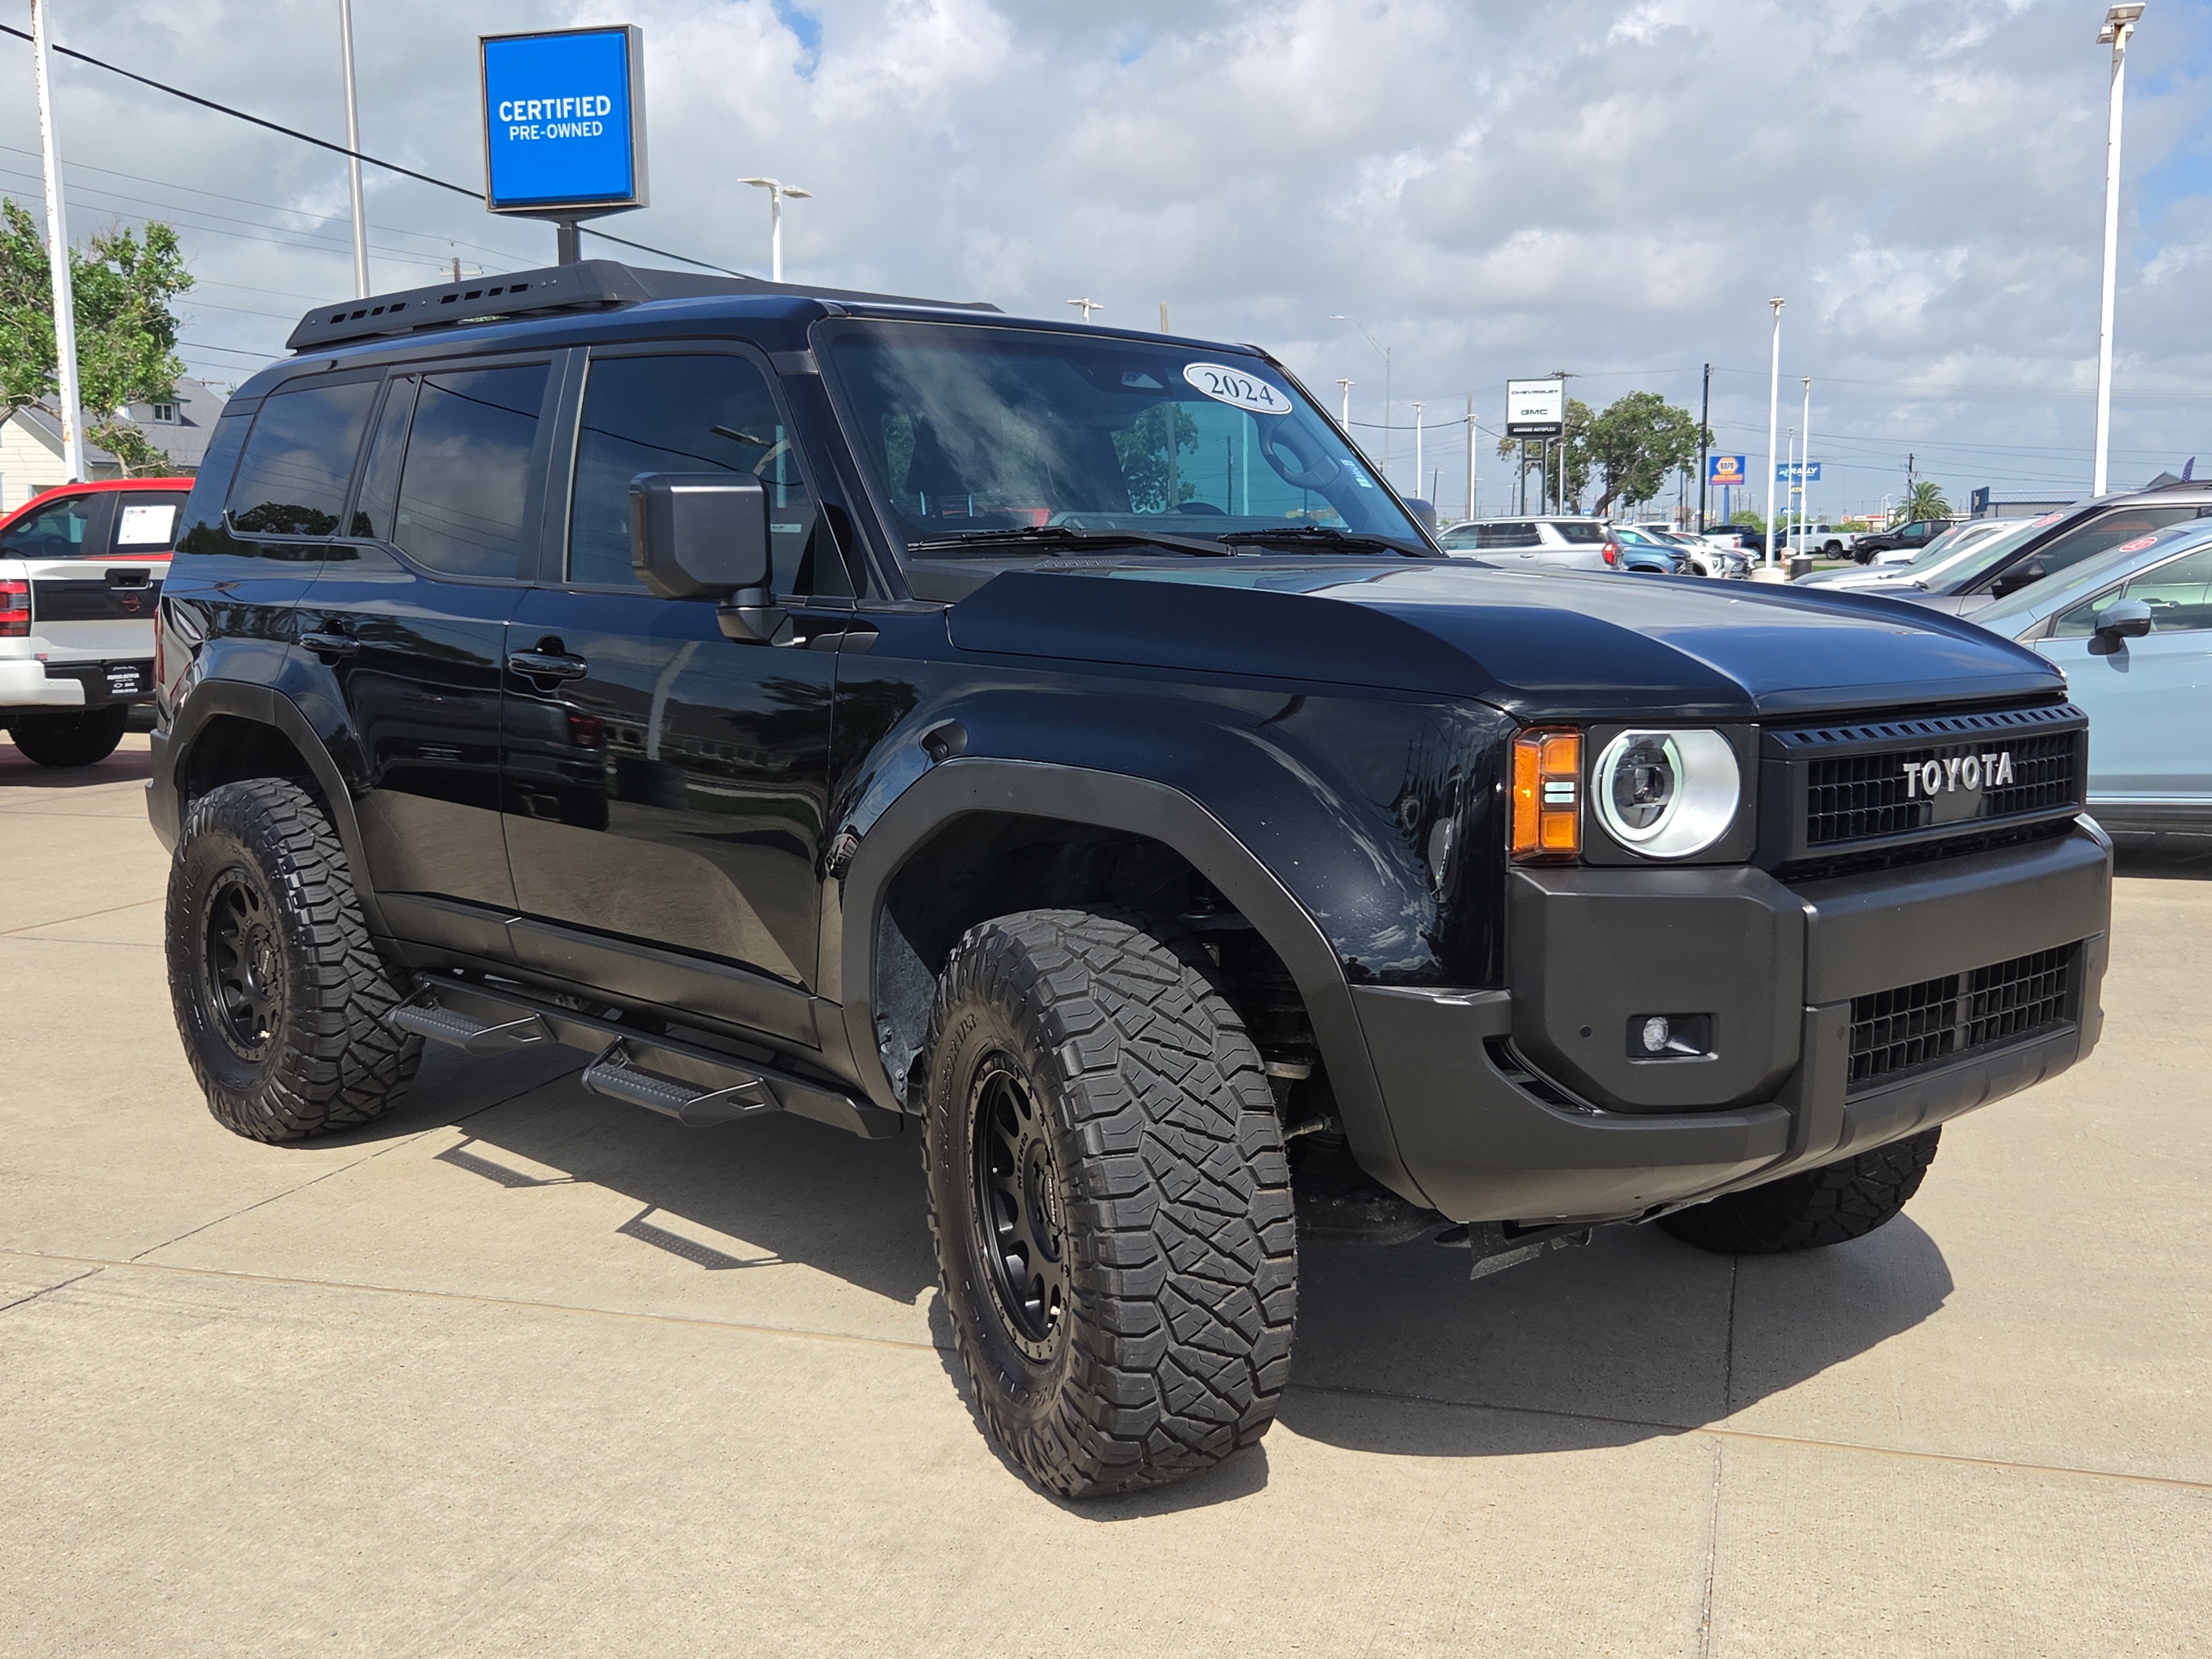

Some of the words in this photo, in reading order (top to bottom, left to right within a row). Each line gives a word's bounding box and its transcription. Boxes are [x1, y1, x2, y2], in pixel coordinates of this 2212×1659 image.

[499, 95, 612, 123] CERTIFIED
[509, 120, 603, 142] PRE-OWNED
[1205, 372, 1274, 406] 2024
[1903, 751, 2014, 798] TOYOTA
